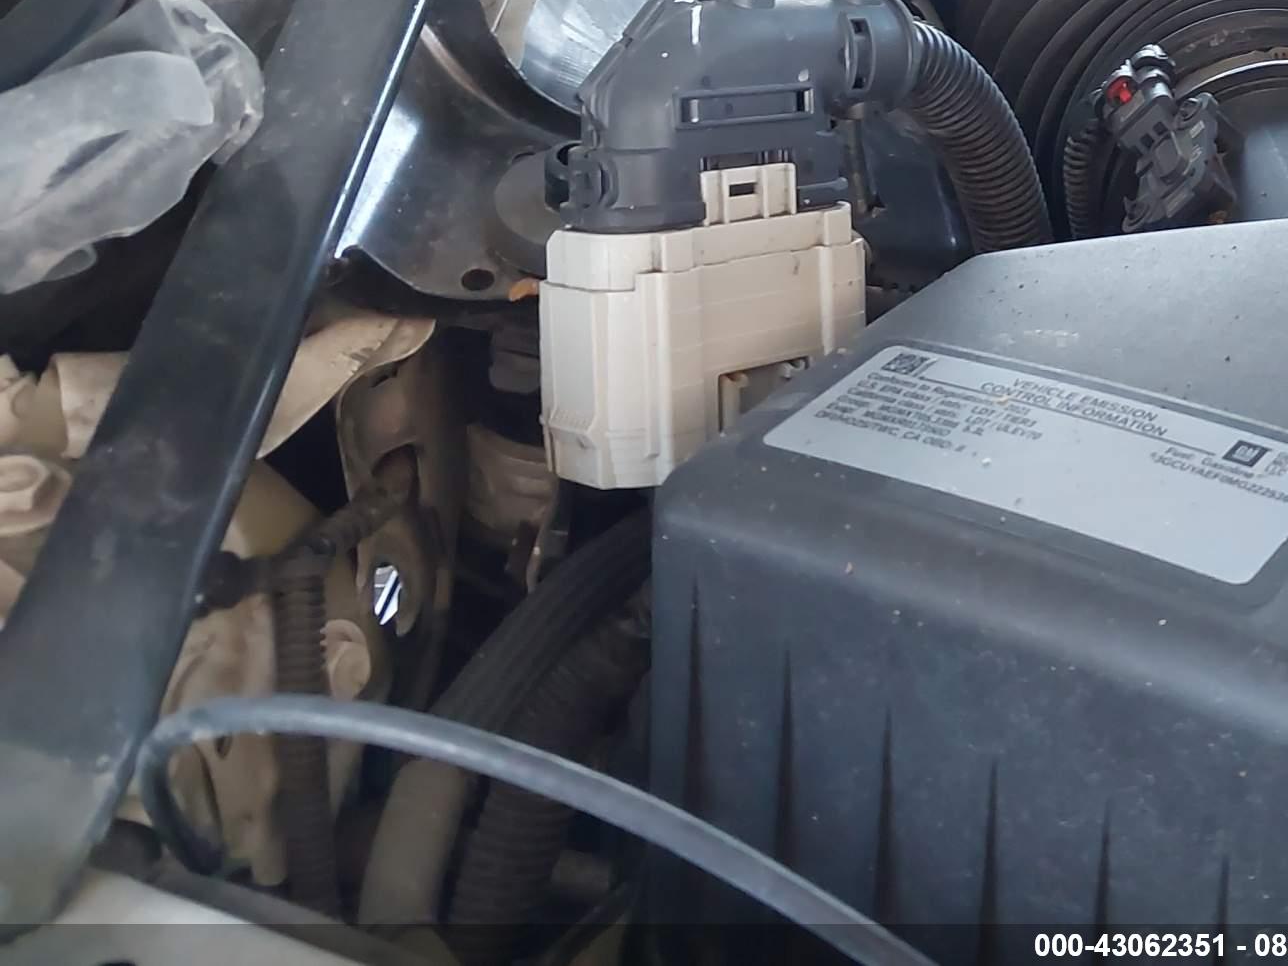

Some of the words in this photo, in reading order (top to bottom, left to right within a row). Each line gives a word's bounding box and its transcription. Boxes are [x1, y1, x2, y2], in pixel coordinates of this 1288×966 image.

[980, 382, 1054, 407] CONTROL
[1057, 401, 1168, 437] INFORMATION
[1013, 378, 1079, 400] VEHICLE
[1080, 395, 1158, 421] EMISSION
[1201, 457, 1255, 479] Gasoline
